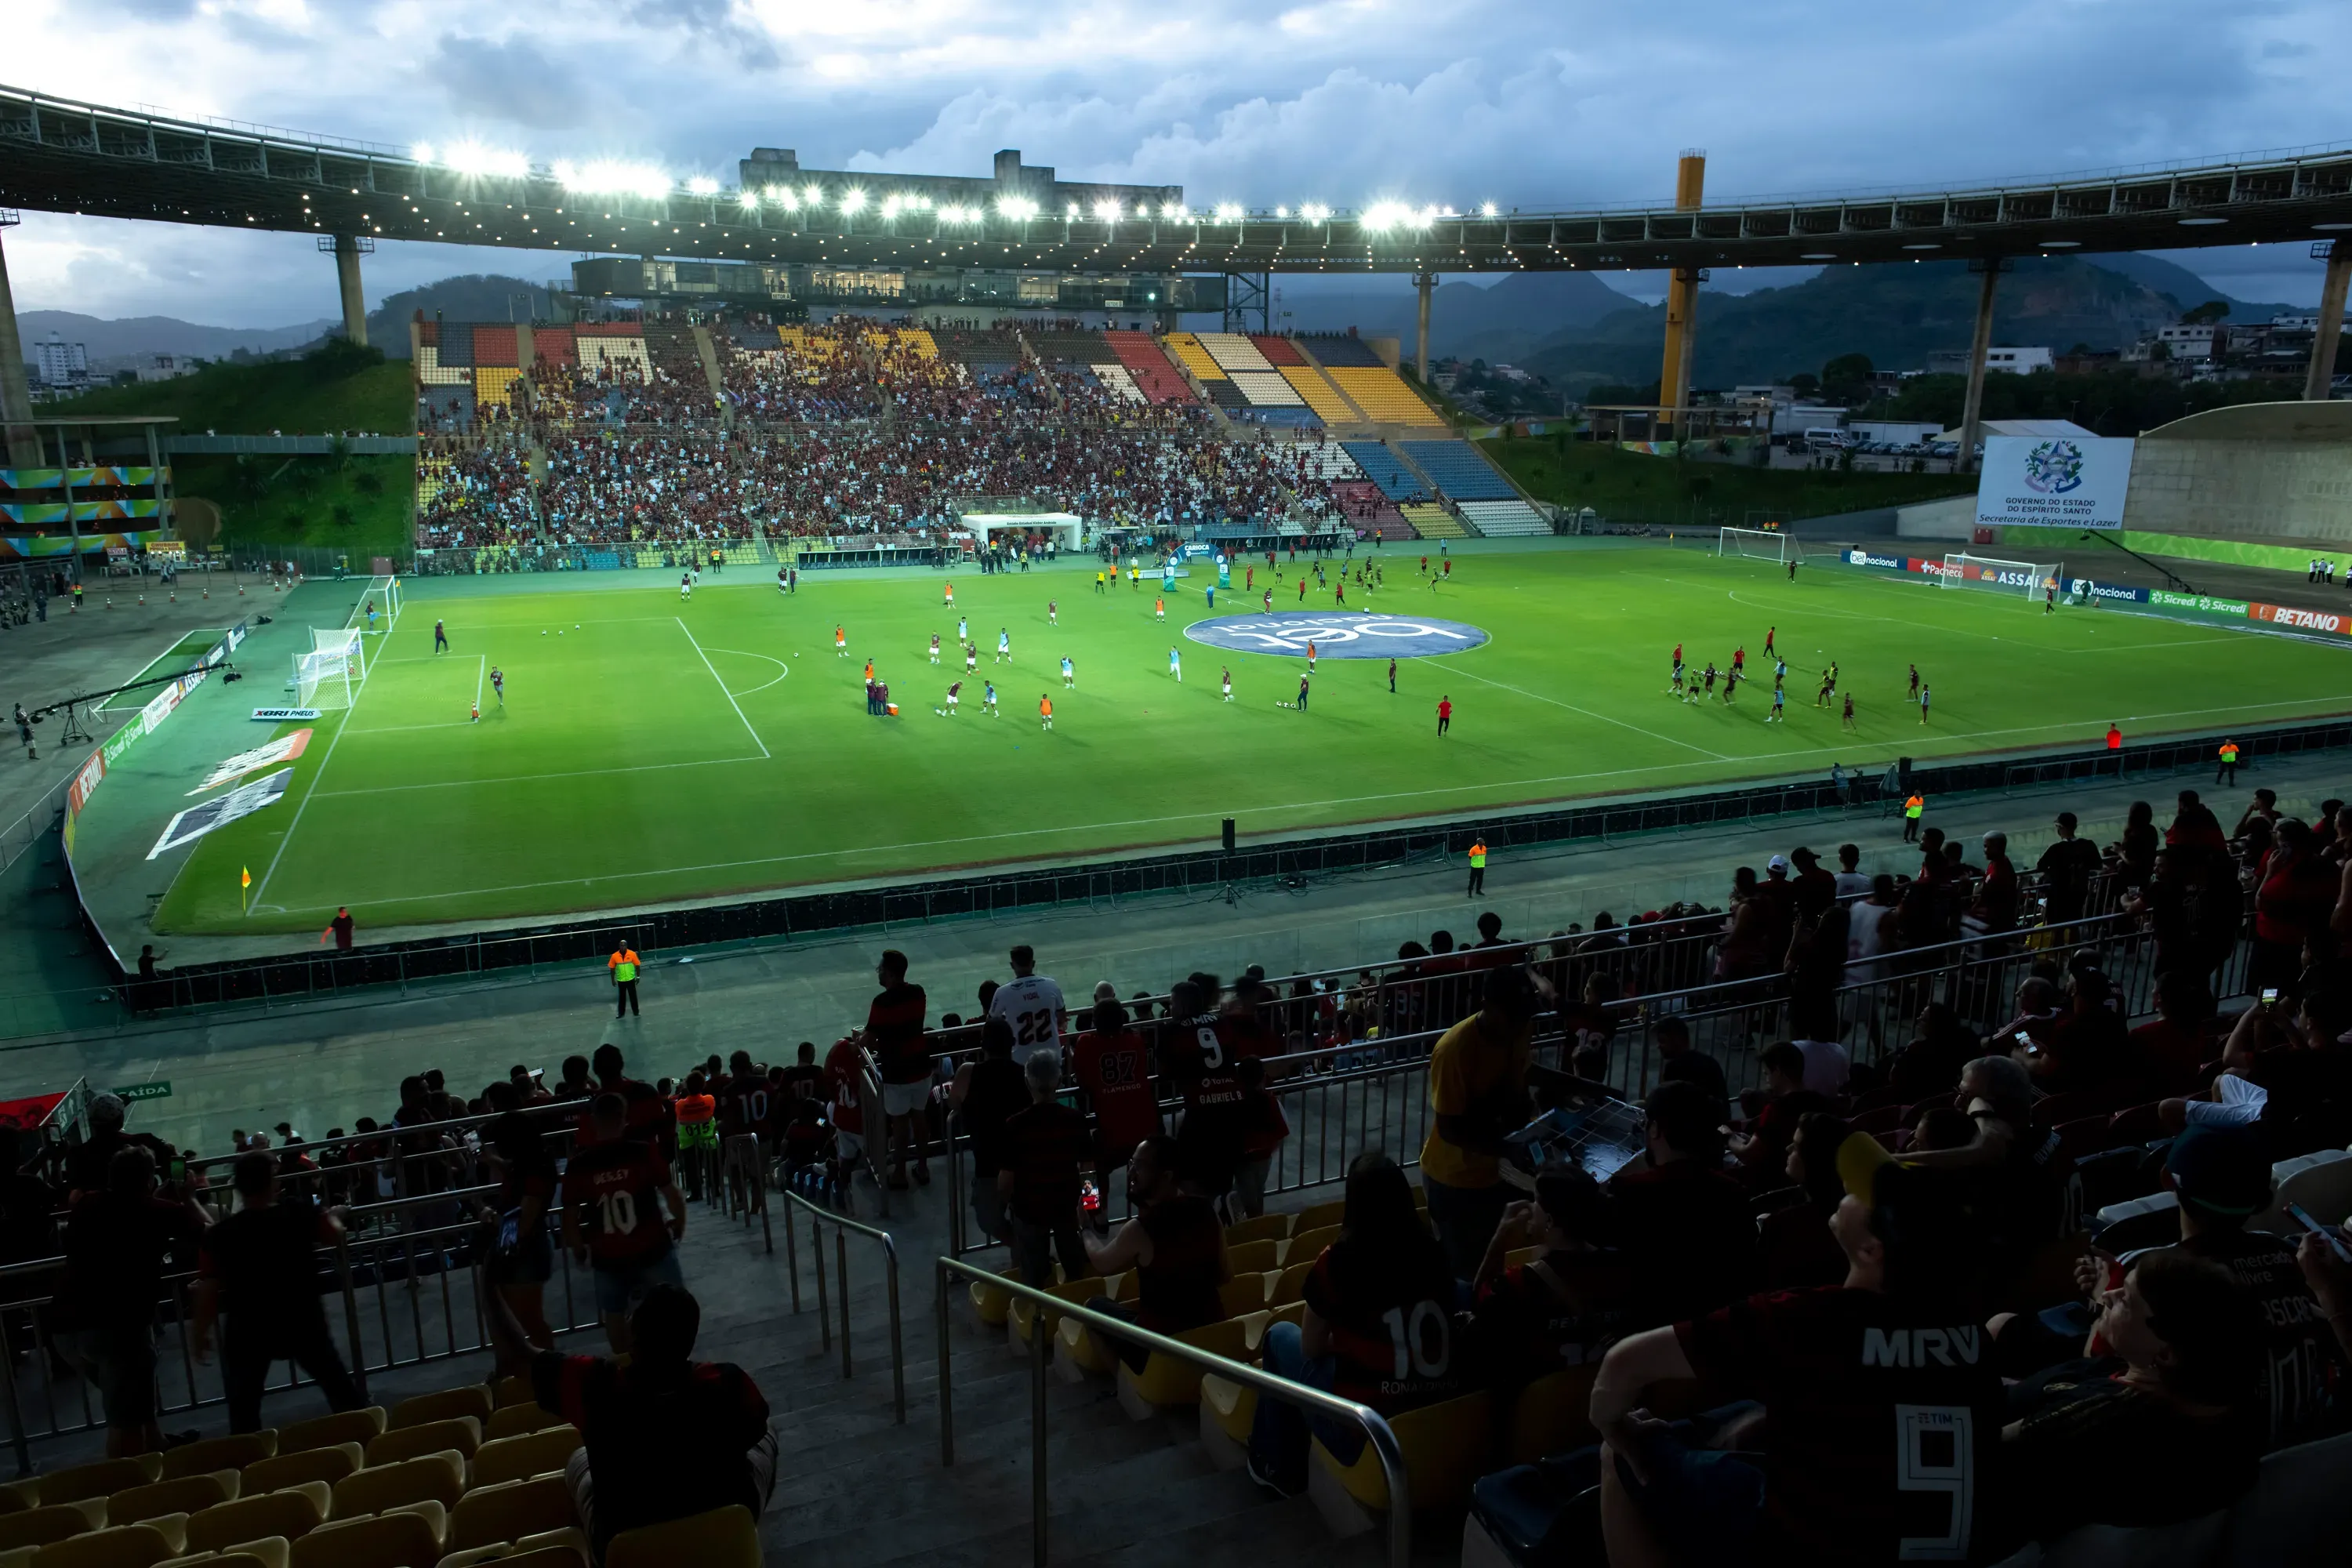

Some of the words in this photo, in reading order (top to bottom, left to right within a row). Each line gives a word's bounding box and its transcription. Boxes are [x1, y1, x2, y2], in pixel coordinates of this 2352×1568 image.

[2005, 497, 2045, 506] GOVERNO
[2021, 505, 2060, 514] ESPÍRITO
[1979, 514, 2026, 524] Secretaria
[2042, 517, 2081, 528] Esportes
[2090, 518, 2118, 528] Lazer
[1851, 551, 1866, 564] bet
[1866, 557, 1898, 568] nacional
[1930, 564, 1964, 578] Pacheco
[2092, 585, 2136, 601] nacional
[2163, 593, 2196, 608] Sicredi
[2212, 601, 2246, 614] Sicredi
[2273, 607, 2339, 632] BETANO
[79, 754, 102, 804] BETANO
[1022, 992, 1040, 1001] VIDAL
[1017, 1007, 1052, 1046] 22
[1196, 1027, 1223, 1069] 9
[1099, 1049, 1138, 1086] 87
[791, 1078, 815, 1098] 10
[1102, 1082, 1142, 1094] FLAMENGO
[1211, 1076, 1235, 1085] TOTAL
[1199, 1092, 1236, 1106] GABRIEL
[737, 1090, 769, 1125] 10
[686, 1123, 710, 1137] 015
[596, 1189, 638, 1236] 10
[2234, 1250, 2293, 1271] mercado
[2238, 1270, 2274, 1285] livre
[1381, 1298, 1450, 1380] 10
[1861, 1325, 1980, 1368] MRV
[1933, 1414, 1952, 1424] TIM
[1895, 1403, 1974, 1561] 9
